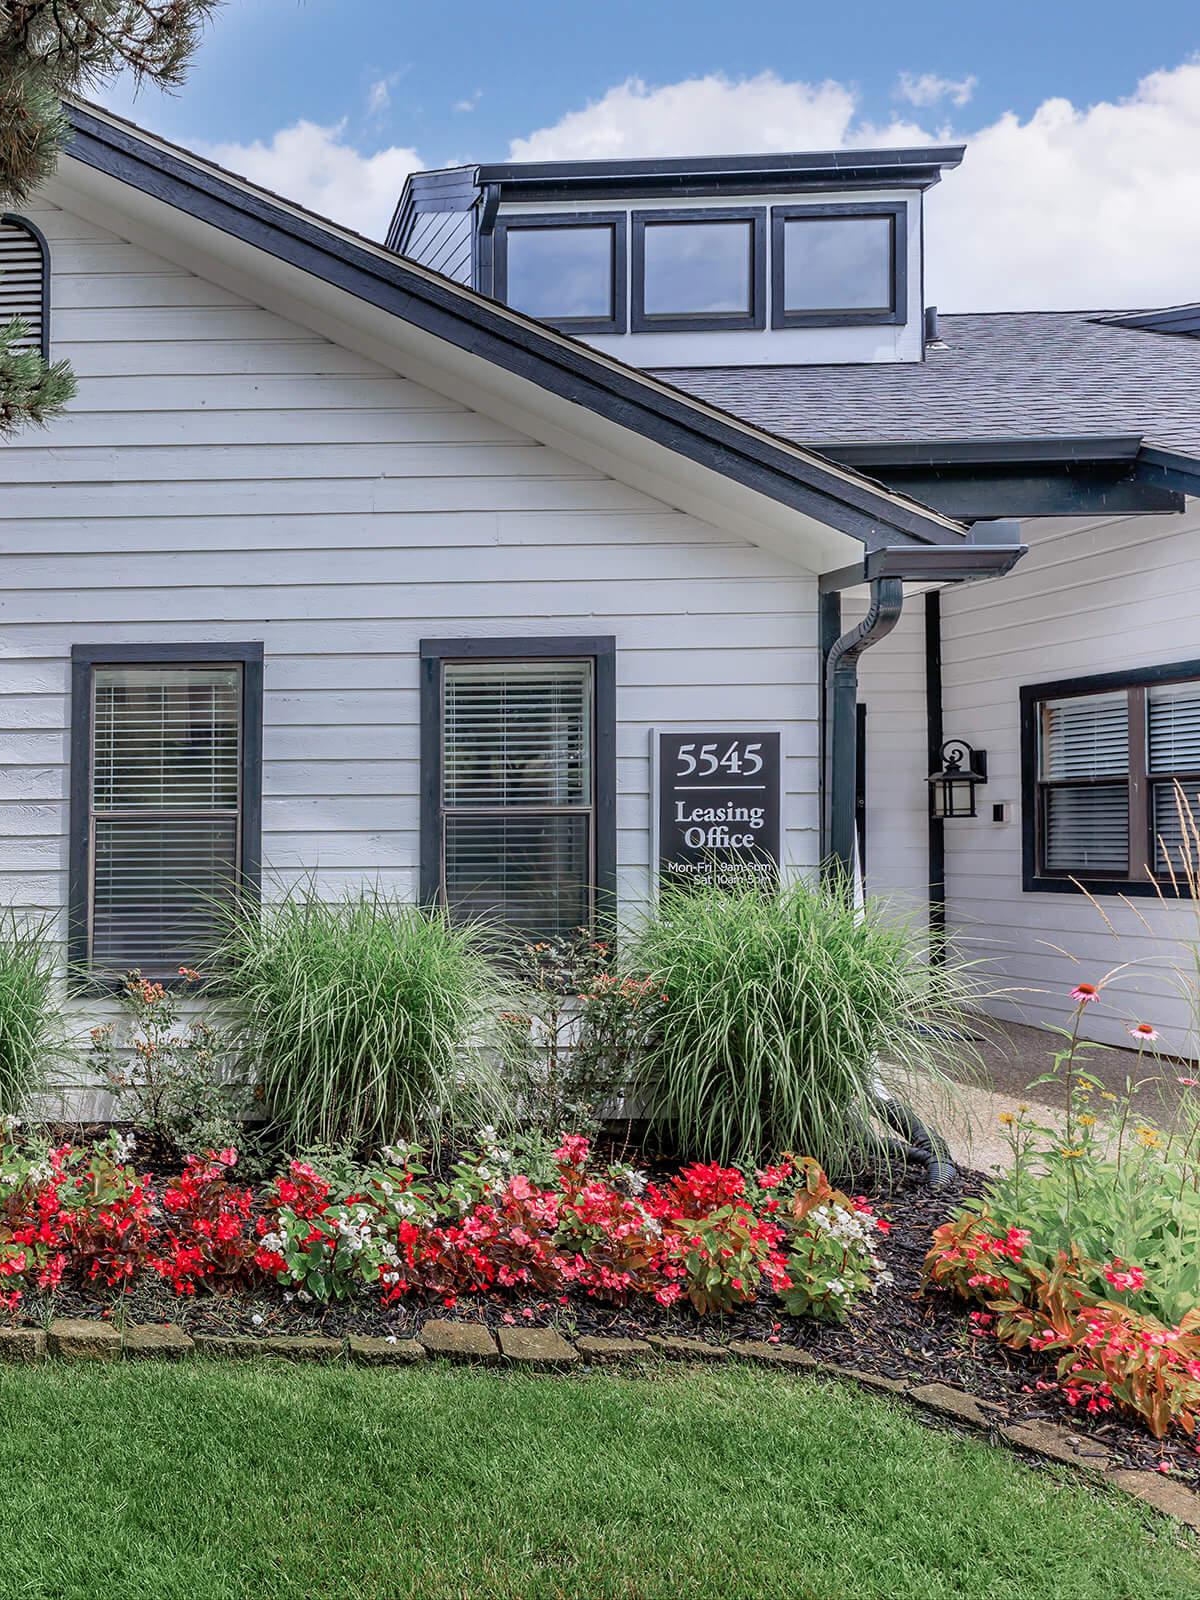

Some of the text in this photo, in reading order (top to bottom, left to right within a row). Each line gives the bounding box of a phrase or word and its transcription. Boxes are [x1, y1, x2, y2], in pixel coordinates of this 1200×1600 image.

[676, 741, 763, 776] 5545
[674, 801, 765, 829] Leasing
[684, 826, 755, 848] Office
[668, 862, 712, 873] Mon-Fri
